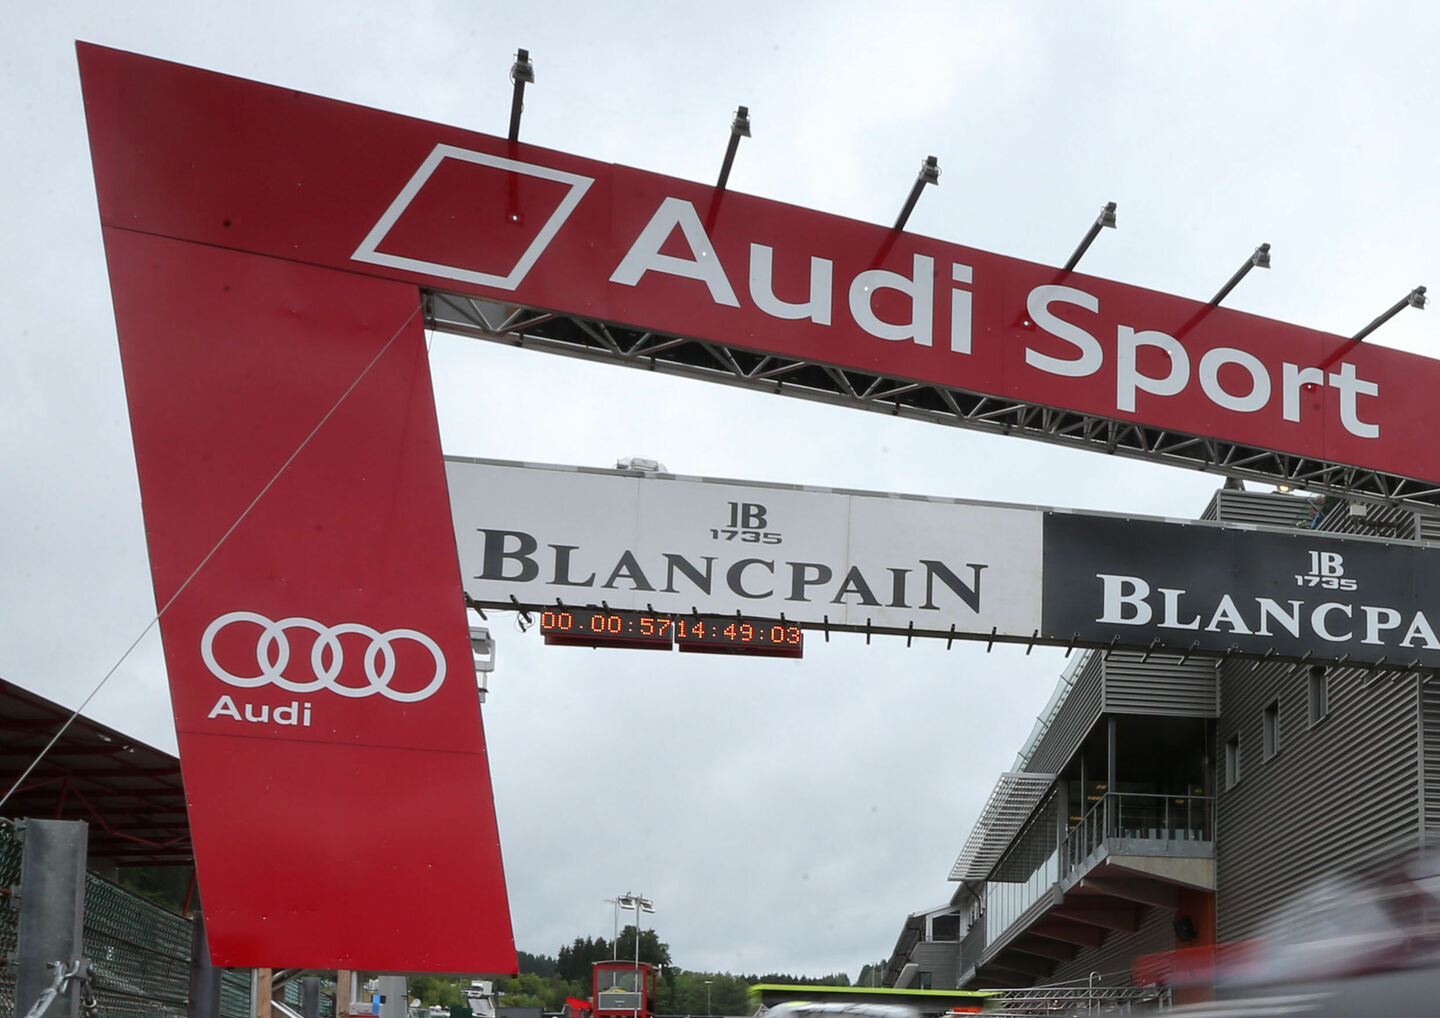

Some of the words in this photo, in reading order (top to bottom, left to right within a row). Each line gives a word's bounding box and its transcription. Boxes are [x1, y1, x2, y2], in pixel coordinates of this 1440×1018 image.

[608, 196, 974, 355] Audi
[1024, 284, 1380, 439] Sport
[710, 528, 783, 545] 1735
[472, 528, 989, 615] BLANCPAIN
[1294, 574, 1358, 591] 1735
[677, 620, 801, 644] 14:49:03
[207, 695, 311, 727] Audi
